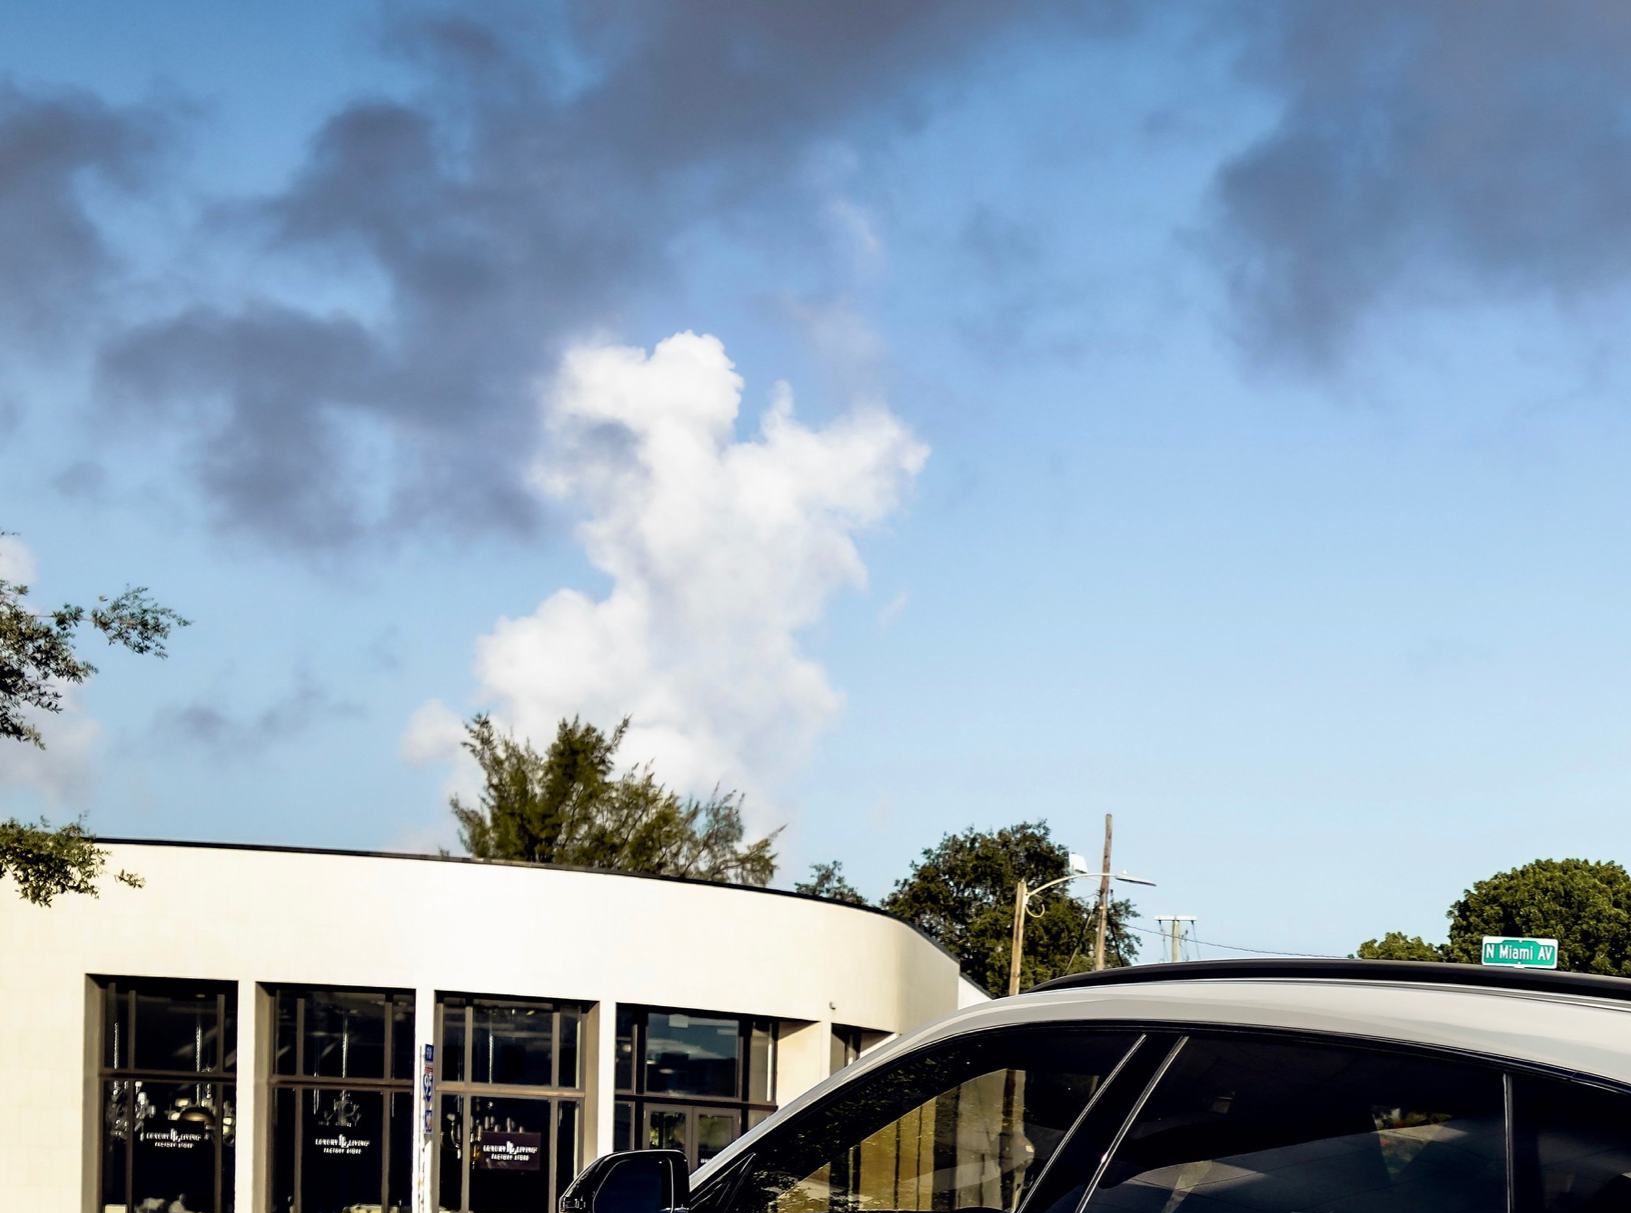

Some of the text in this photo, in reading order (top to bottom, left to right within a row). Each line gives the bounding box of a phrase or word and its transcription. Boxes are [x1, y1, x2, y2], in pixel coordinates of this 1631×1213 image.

[1486, 944, 1553, 961] N Miami AV
